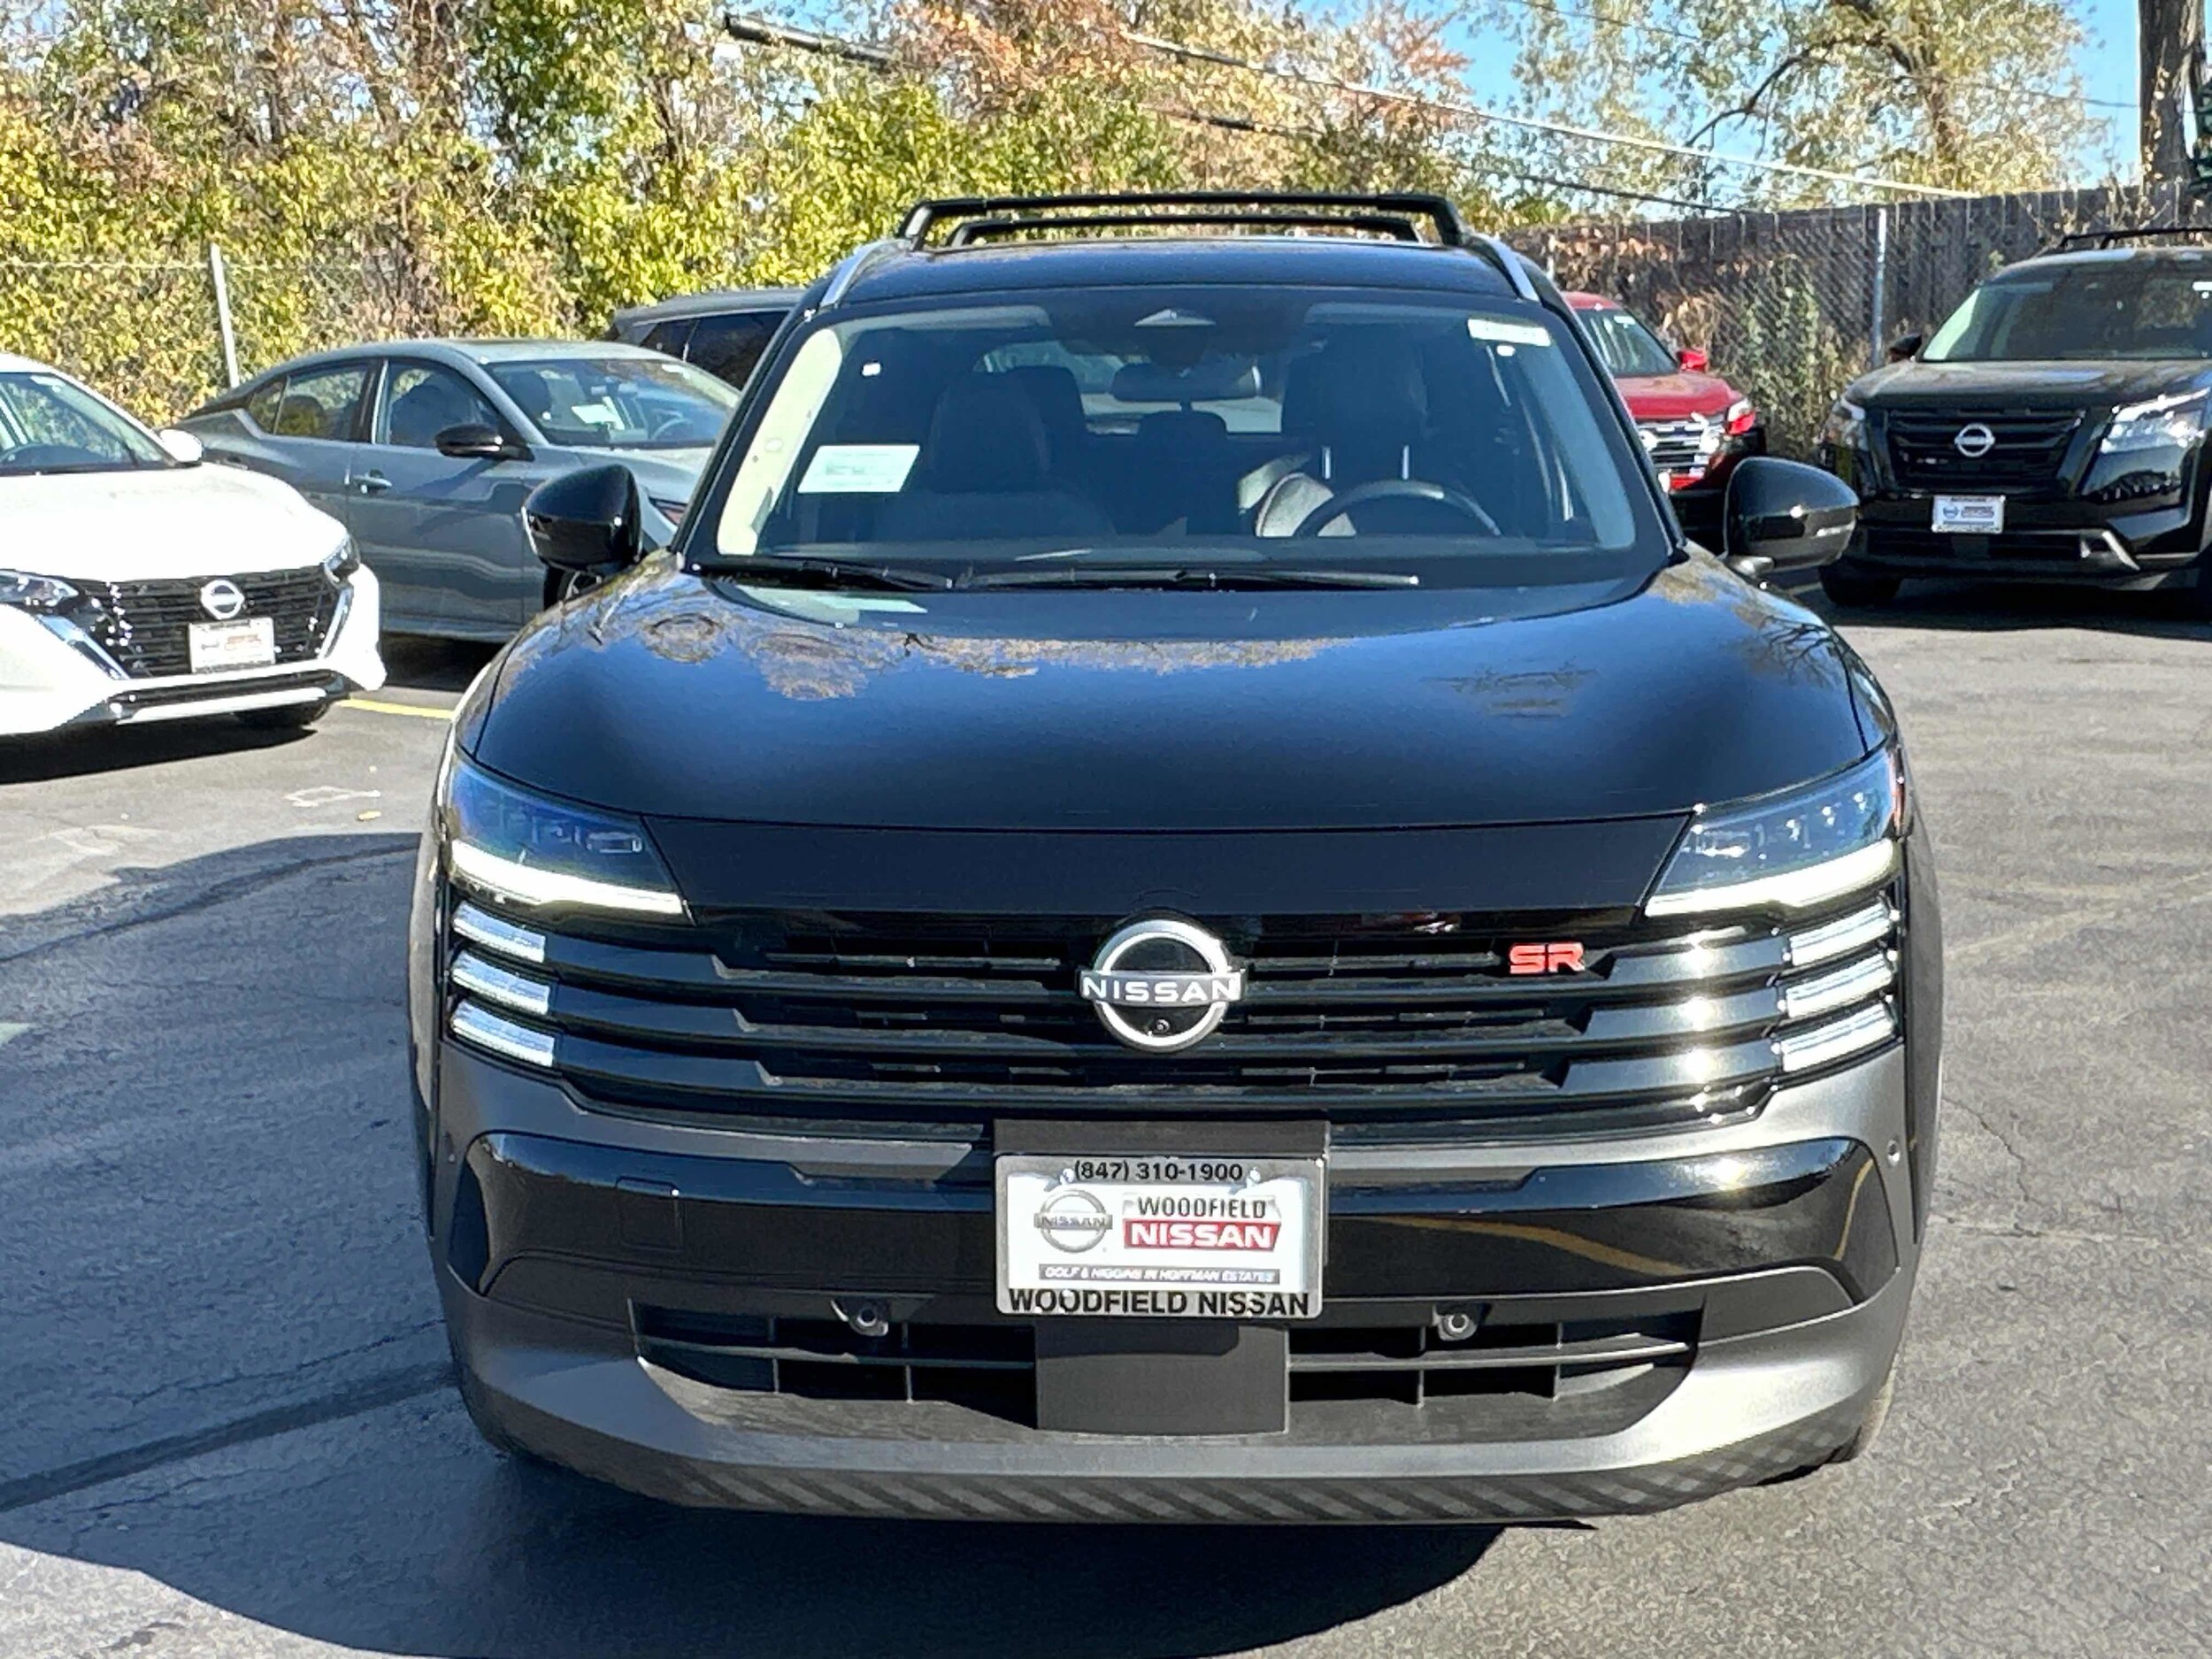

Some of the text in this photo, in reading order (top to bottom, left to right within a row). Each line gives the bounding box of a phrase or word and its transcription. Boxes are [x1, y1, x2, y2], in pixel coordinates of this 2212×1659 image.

[1509, 942, 1586, 973] SR
[1082, 976, 1240, 1003] NISSAN
[1074, 1160, 1243, 1182] (847) 310-1900
[1138, 1196, 1265, 1219] WOODFIELD
[1041, 1215, 1105, 1228] NISSAN
[1131, 1225, 1272, 1249] NISSAN
[1045, 1266, 1080, 1278] GOLF
[1008, 1288, 1309, 1317] WOODFIELD NISSAN
